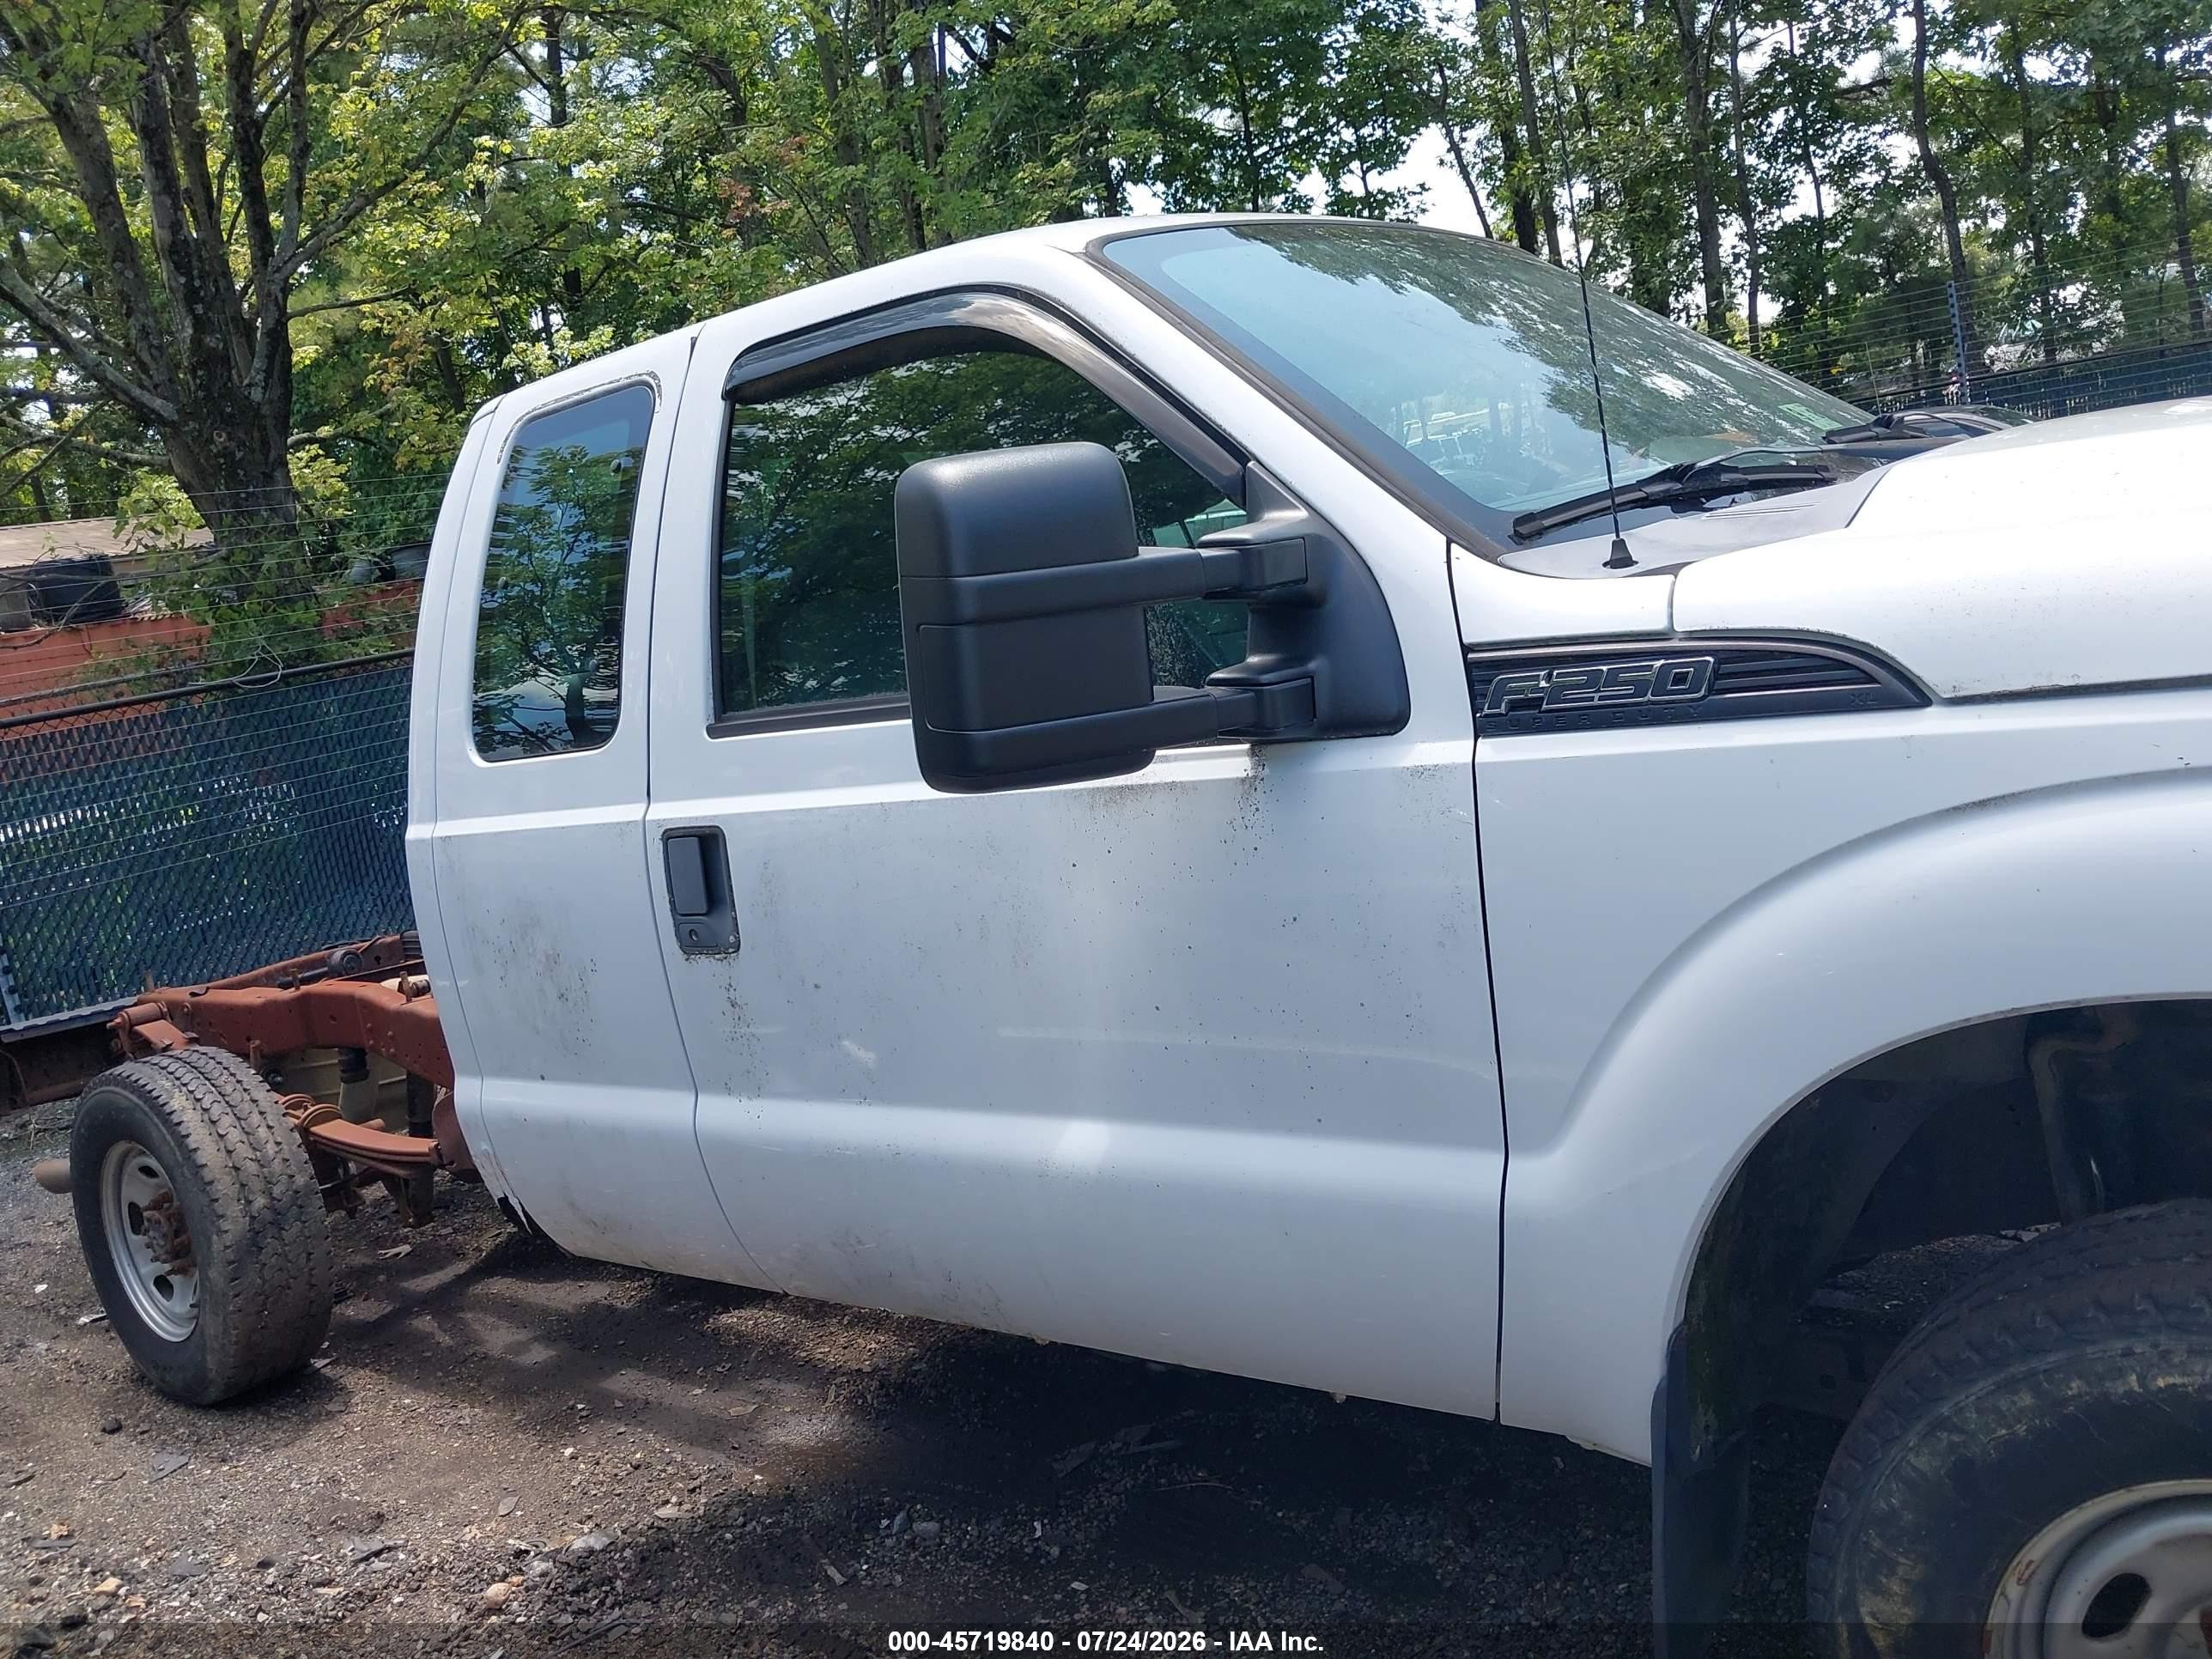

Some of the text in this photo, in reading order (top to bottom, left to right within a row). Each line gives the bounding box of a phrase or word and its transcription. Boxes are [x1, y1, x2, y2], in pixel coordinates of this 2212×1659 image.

[1849, 693, 1879, 705] XL
[1486, 705, 1704, 730] SUPER DUTY
